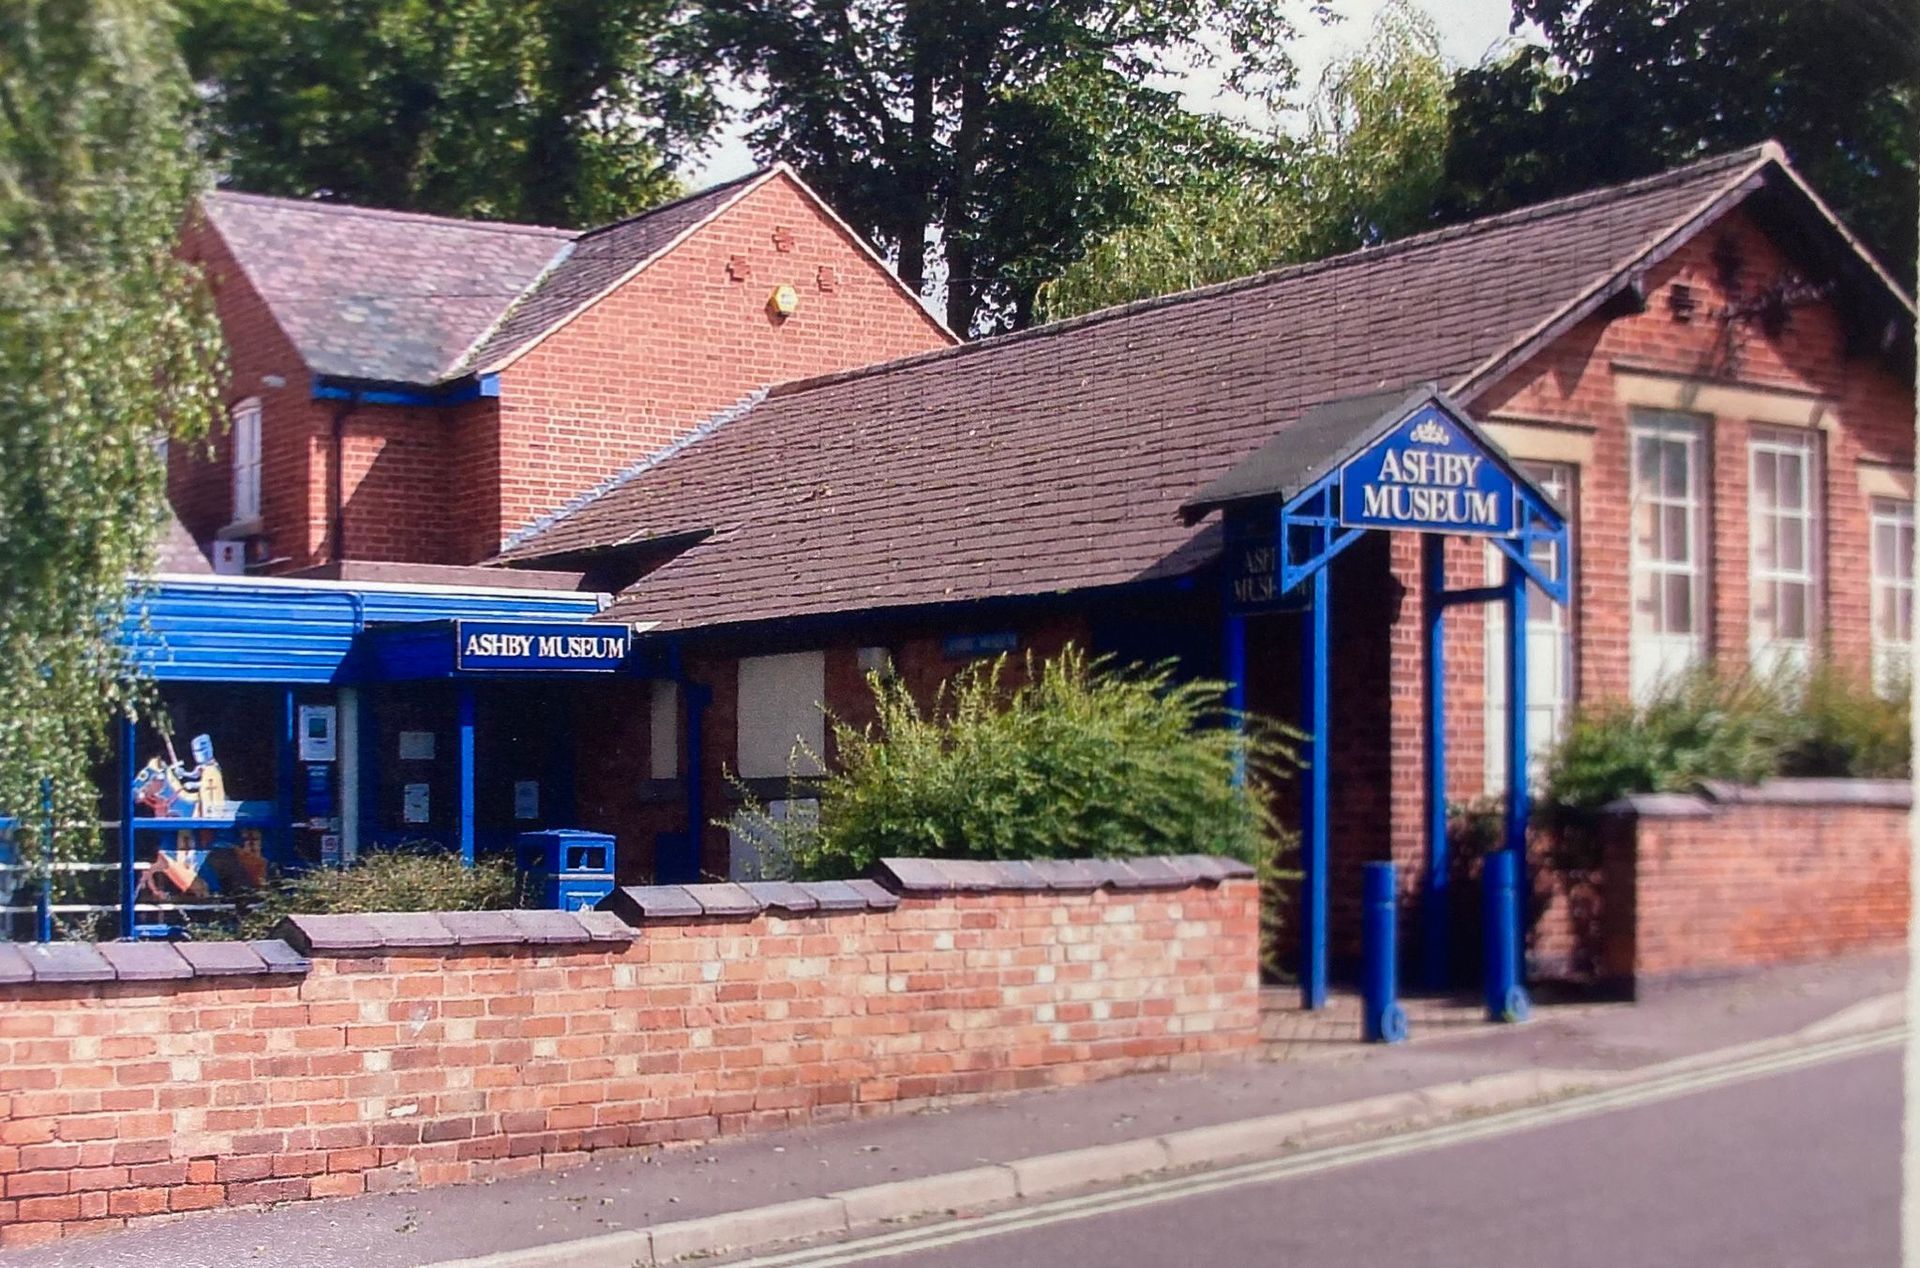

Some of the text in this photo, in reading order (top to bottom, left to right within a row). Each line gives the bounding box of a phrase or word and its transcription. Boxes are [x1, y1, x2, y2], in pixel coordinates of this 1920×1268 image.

[1378, 447, 1482, 489] ASHBY
[1362, 484, 1499, 526] MUSEUM
[464, 633, 625, 659] ASHBY MUSEUM
